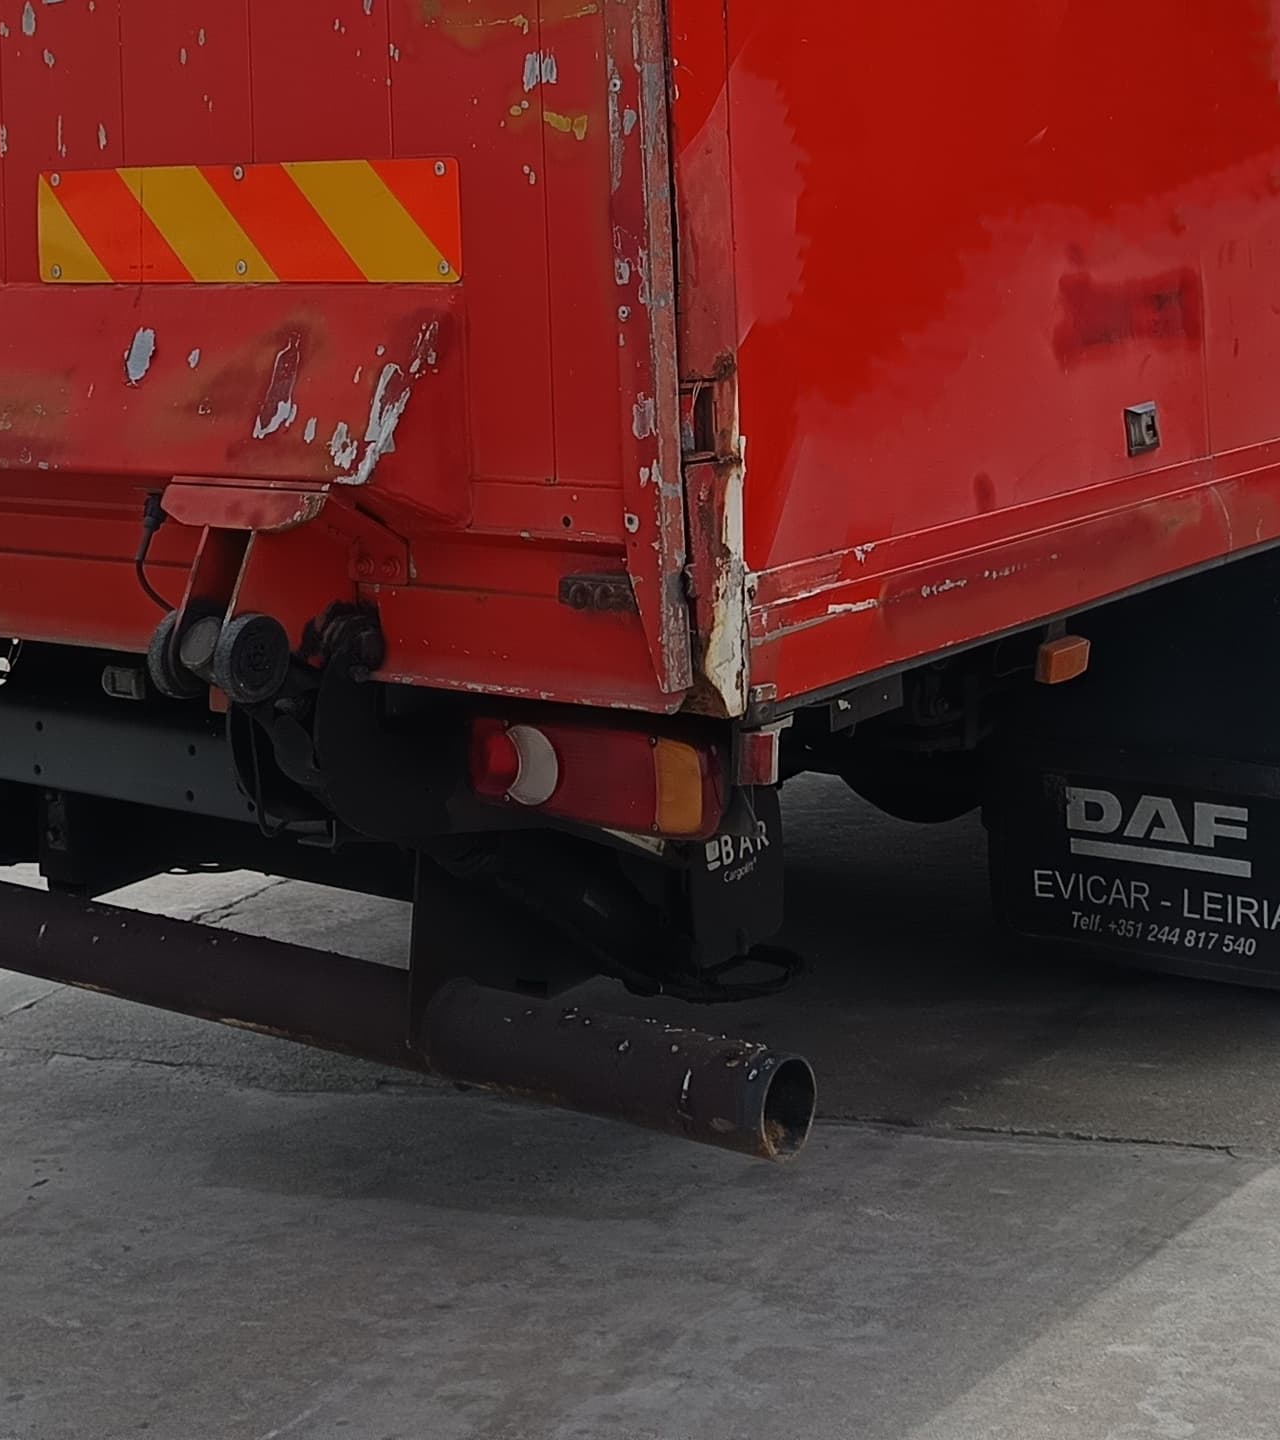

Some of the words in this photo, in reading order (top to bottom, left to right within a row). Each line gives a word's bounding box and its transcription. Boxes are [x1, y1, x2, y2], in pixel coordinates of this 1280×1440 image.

[1065, 787, 1249, 848] DAF
[1033, 869, 1151, 912] EVICAR
[1071, 911, 1103, 933] Telf.
[1107, 917, 1142, 939] +351
[1147, 923, 1181, 946] 244
[1184, 931, 1217, 951] 817
[1222, 935, 1256, 957] 540
